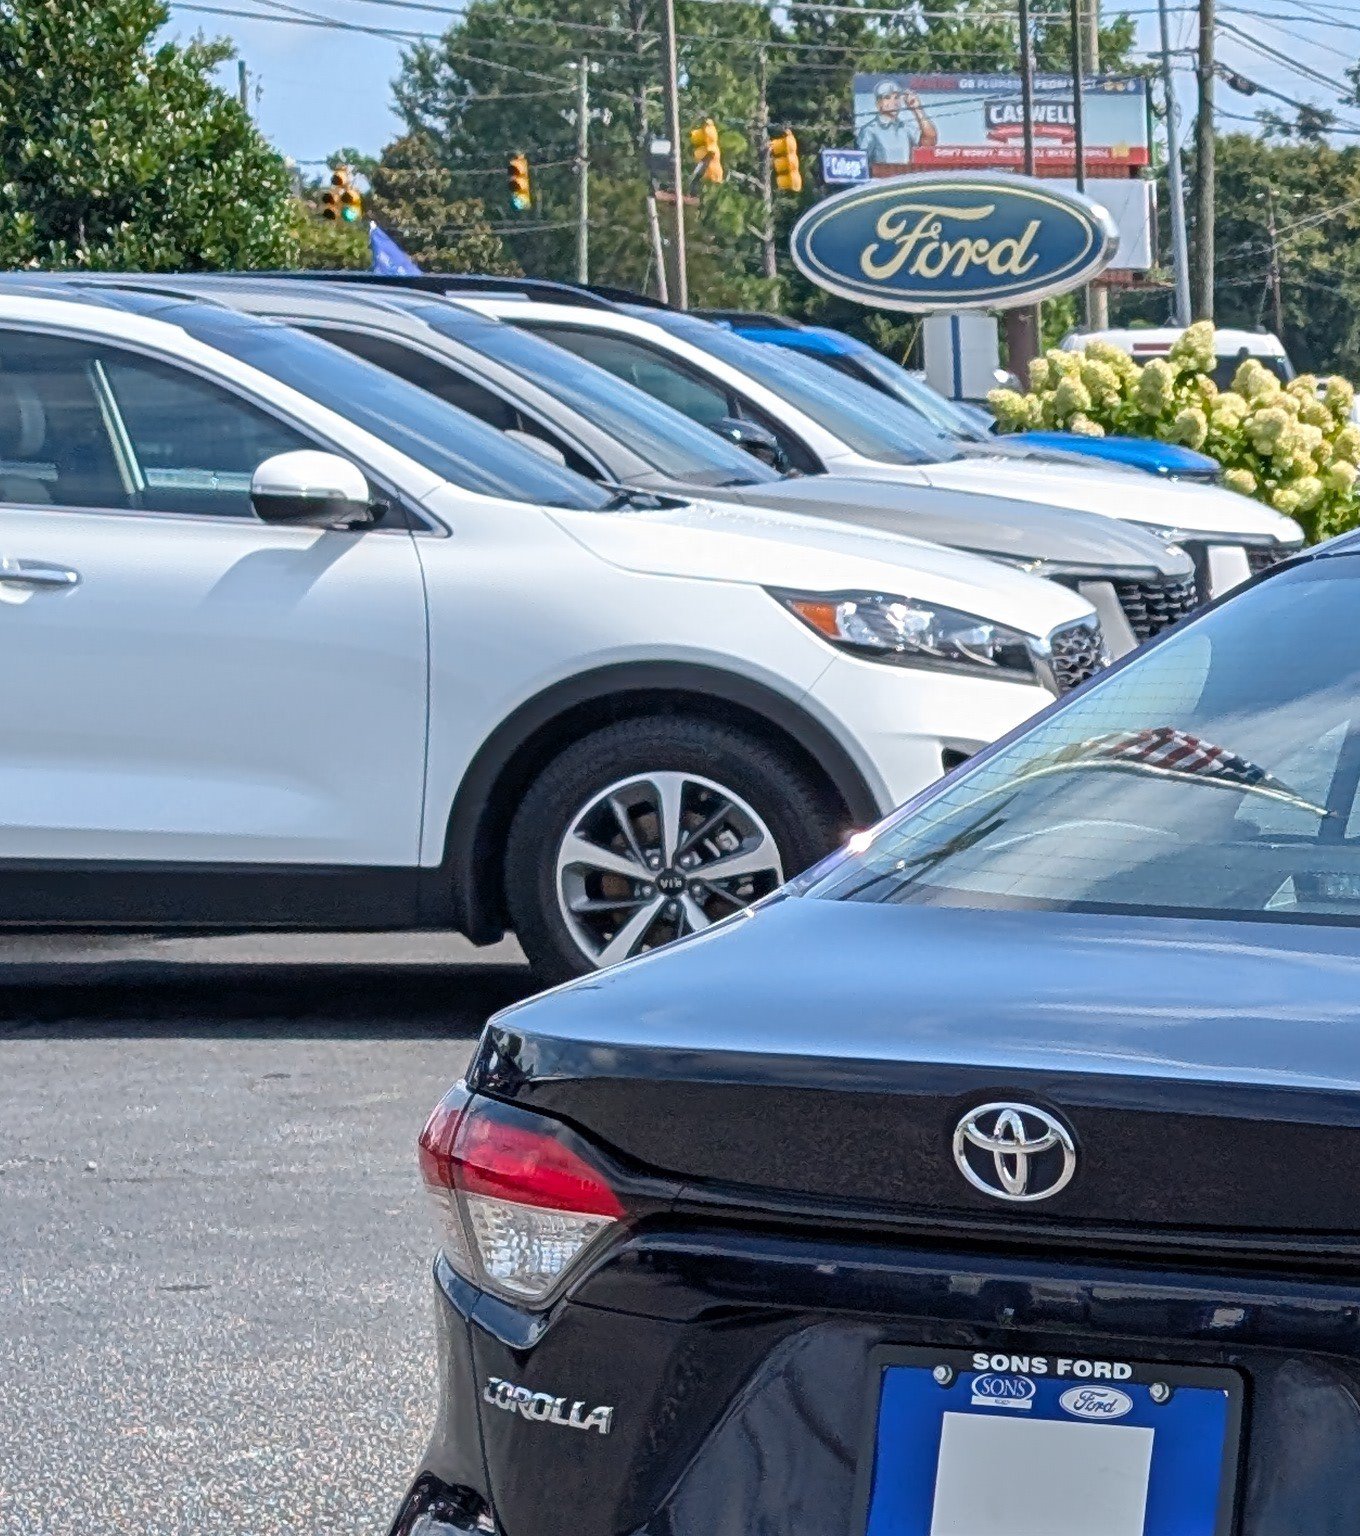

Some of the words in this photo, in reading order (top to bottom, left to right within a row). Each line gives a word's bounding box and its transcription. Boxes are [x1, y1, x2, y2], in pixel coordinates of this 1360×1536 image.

[859, 203, 1042, 281] Ford
[659, 877, 683, 889] KIA
[972, 1353, 1048, 1376] SONS
[1056, 1359, 1133, 1381] FORD
[981, 1377, 1026, 1397] SONS
[484, 1376, 614, 1435] COROLLA
[1073, 1389, 1119, 1415] Ford
